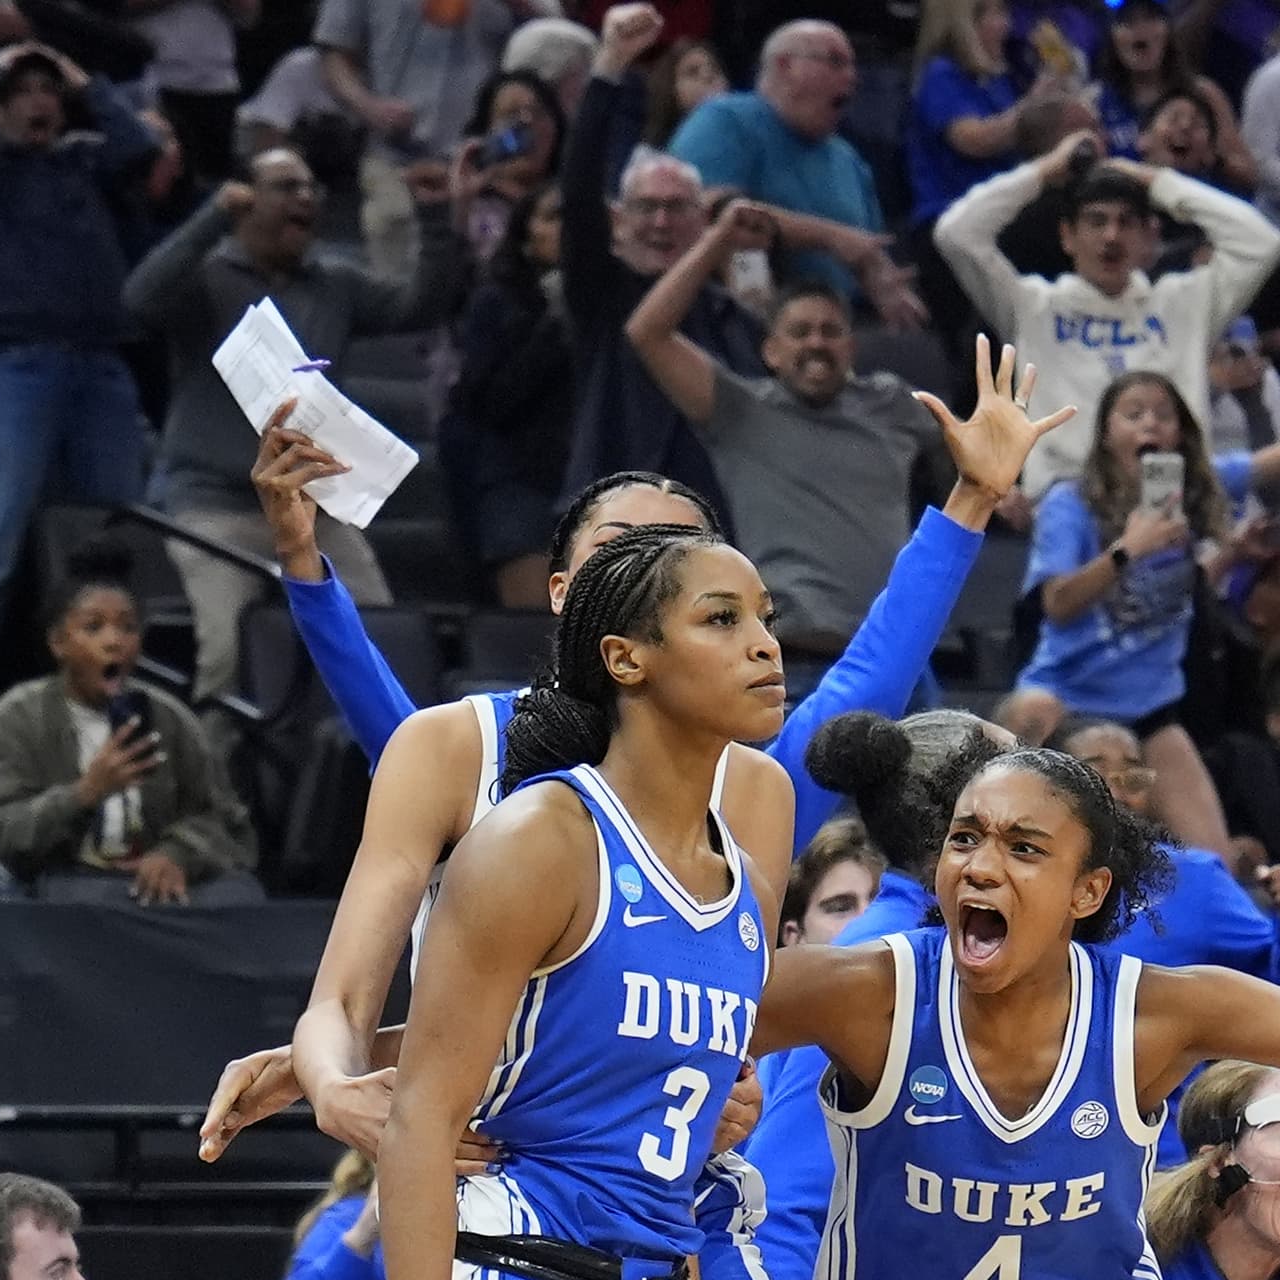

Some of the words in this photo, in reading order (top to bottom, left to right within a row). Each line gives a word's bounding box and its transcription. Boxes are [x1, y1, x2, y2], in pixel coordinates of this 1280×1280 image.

[1054, 313, 1167, 347] UCLA
[911, 1080, 945, 1097] NCAA
[637, 1065, 711, 1182] 3
[1075, 1110, 1105, 1127] ACC
[904, 1161, 1105, 1227] DUKE
